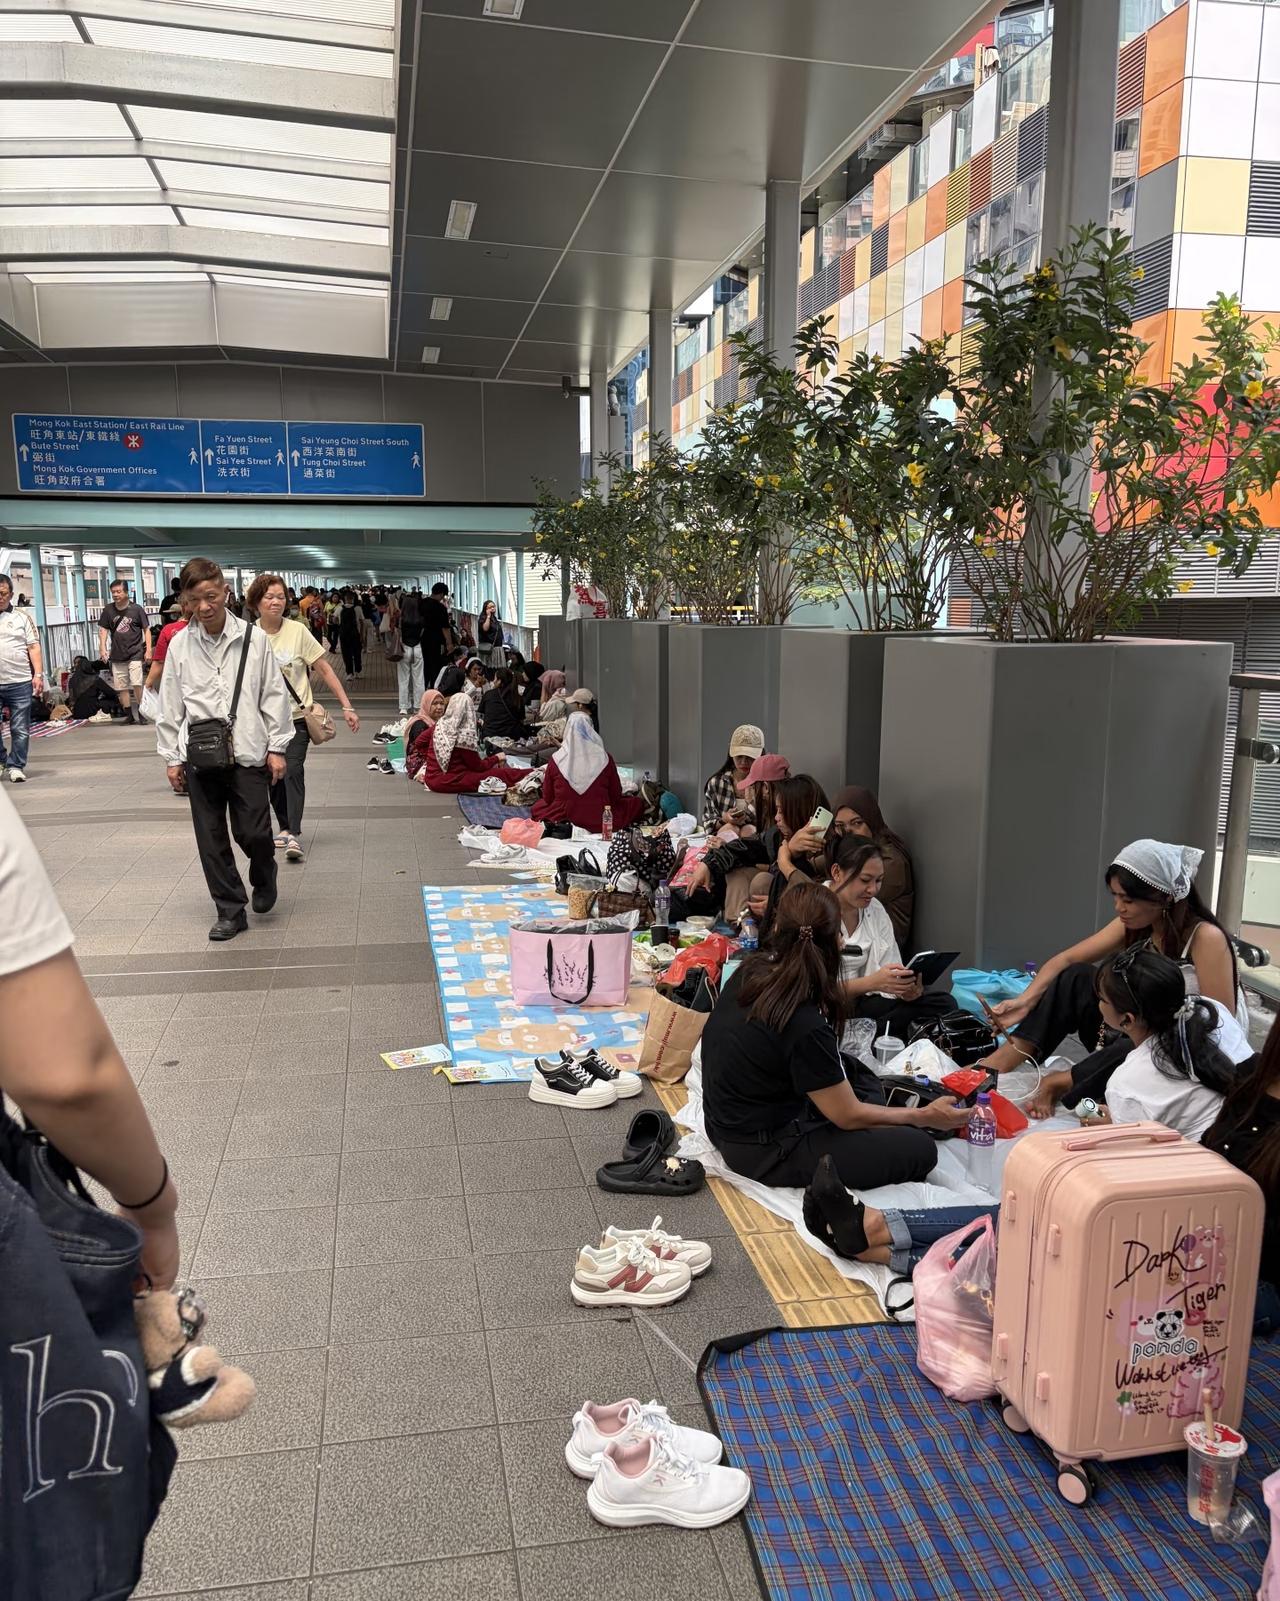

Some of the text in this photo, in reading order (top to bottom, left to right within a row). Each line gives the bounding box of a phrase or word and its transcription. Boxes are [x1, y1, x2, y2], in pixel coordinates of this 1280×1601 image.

[29, 419, 185, 432] Mong Kok East Station/ East Rail Line
[214, 435, 273, 444] Fa Yuen Street
[315, 437, 340, 446] Yeung
[360, 438, 385, 446] Street
[386, 438, 410, 446] South
[31, 442, 80, 451] Bute Street
[216, 445, 250, 456] 花園街
[302, 446, 358, 458] 西洋菜南街
[216, 458, 272, 466] Sai Yee Street
[302, 458, 367, 468] Tung Choi Street
[32, 464, 158, 476] Mong Kok Government Offices
[217, 467, 250, 478] 洗衣街
[303, 468, 336, 479] 通菜街
[34, 475, 106, 487] 旺角政府合署
[970, 1128, 994, 1141] vita
[1114, 1225, 1207, 1289] Dark
[1166, 1282, 1226, 1318] Tiger
[1132, 1338, 1199, 1364] panda
